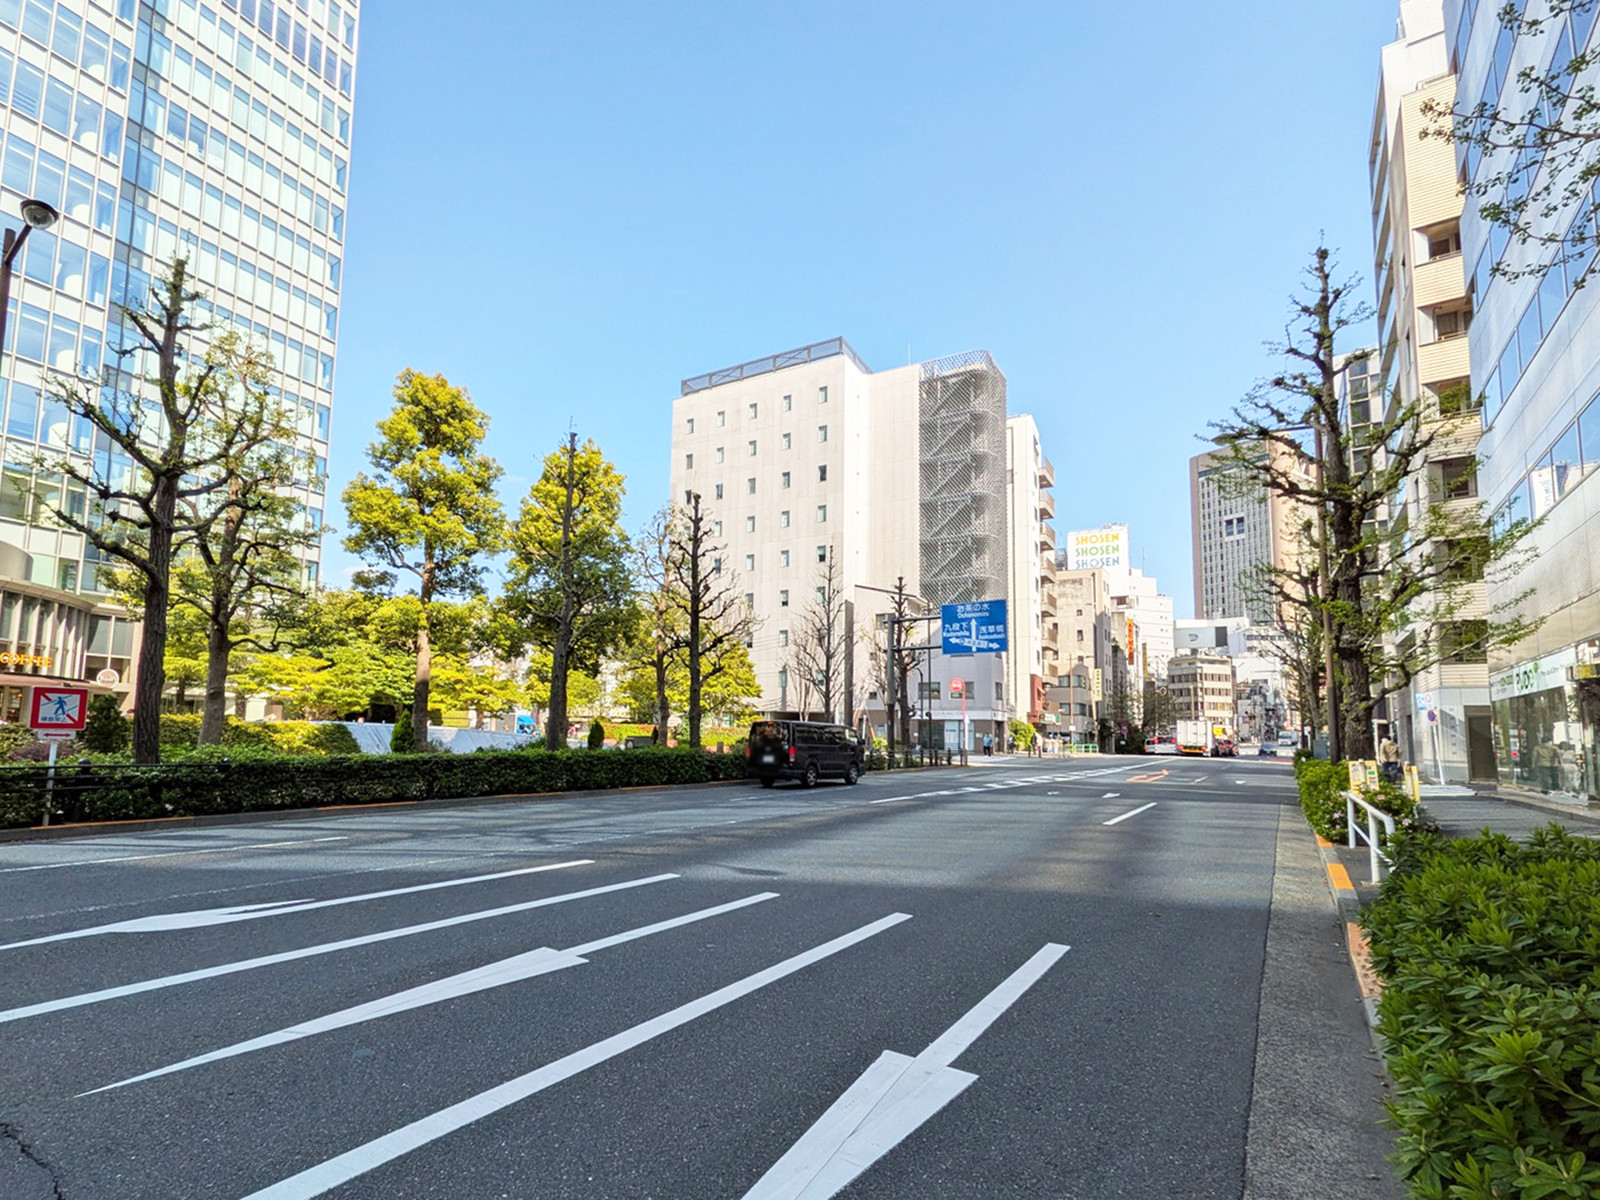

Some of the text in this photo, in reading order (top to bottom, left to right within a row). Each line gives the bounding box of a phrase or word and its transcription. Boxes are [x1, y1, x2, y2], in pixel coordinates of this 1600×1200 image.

[1075, 532, 1119, 546] SHOSEN
[1075, 544, 1119, 557] SHOSEN
[1076, 556, 1120, 569] SHOSEN
[956, 603, 990, 613] お茶の水
[944, 621, 969, 631] 九段下
[0, 652, 53, 668] COFFEE
